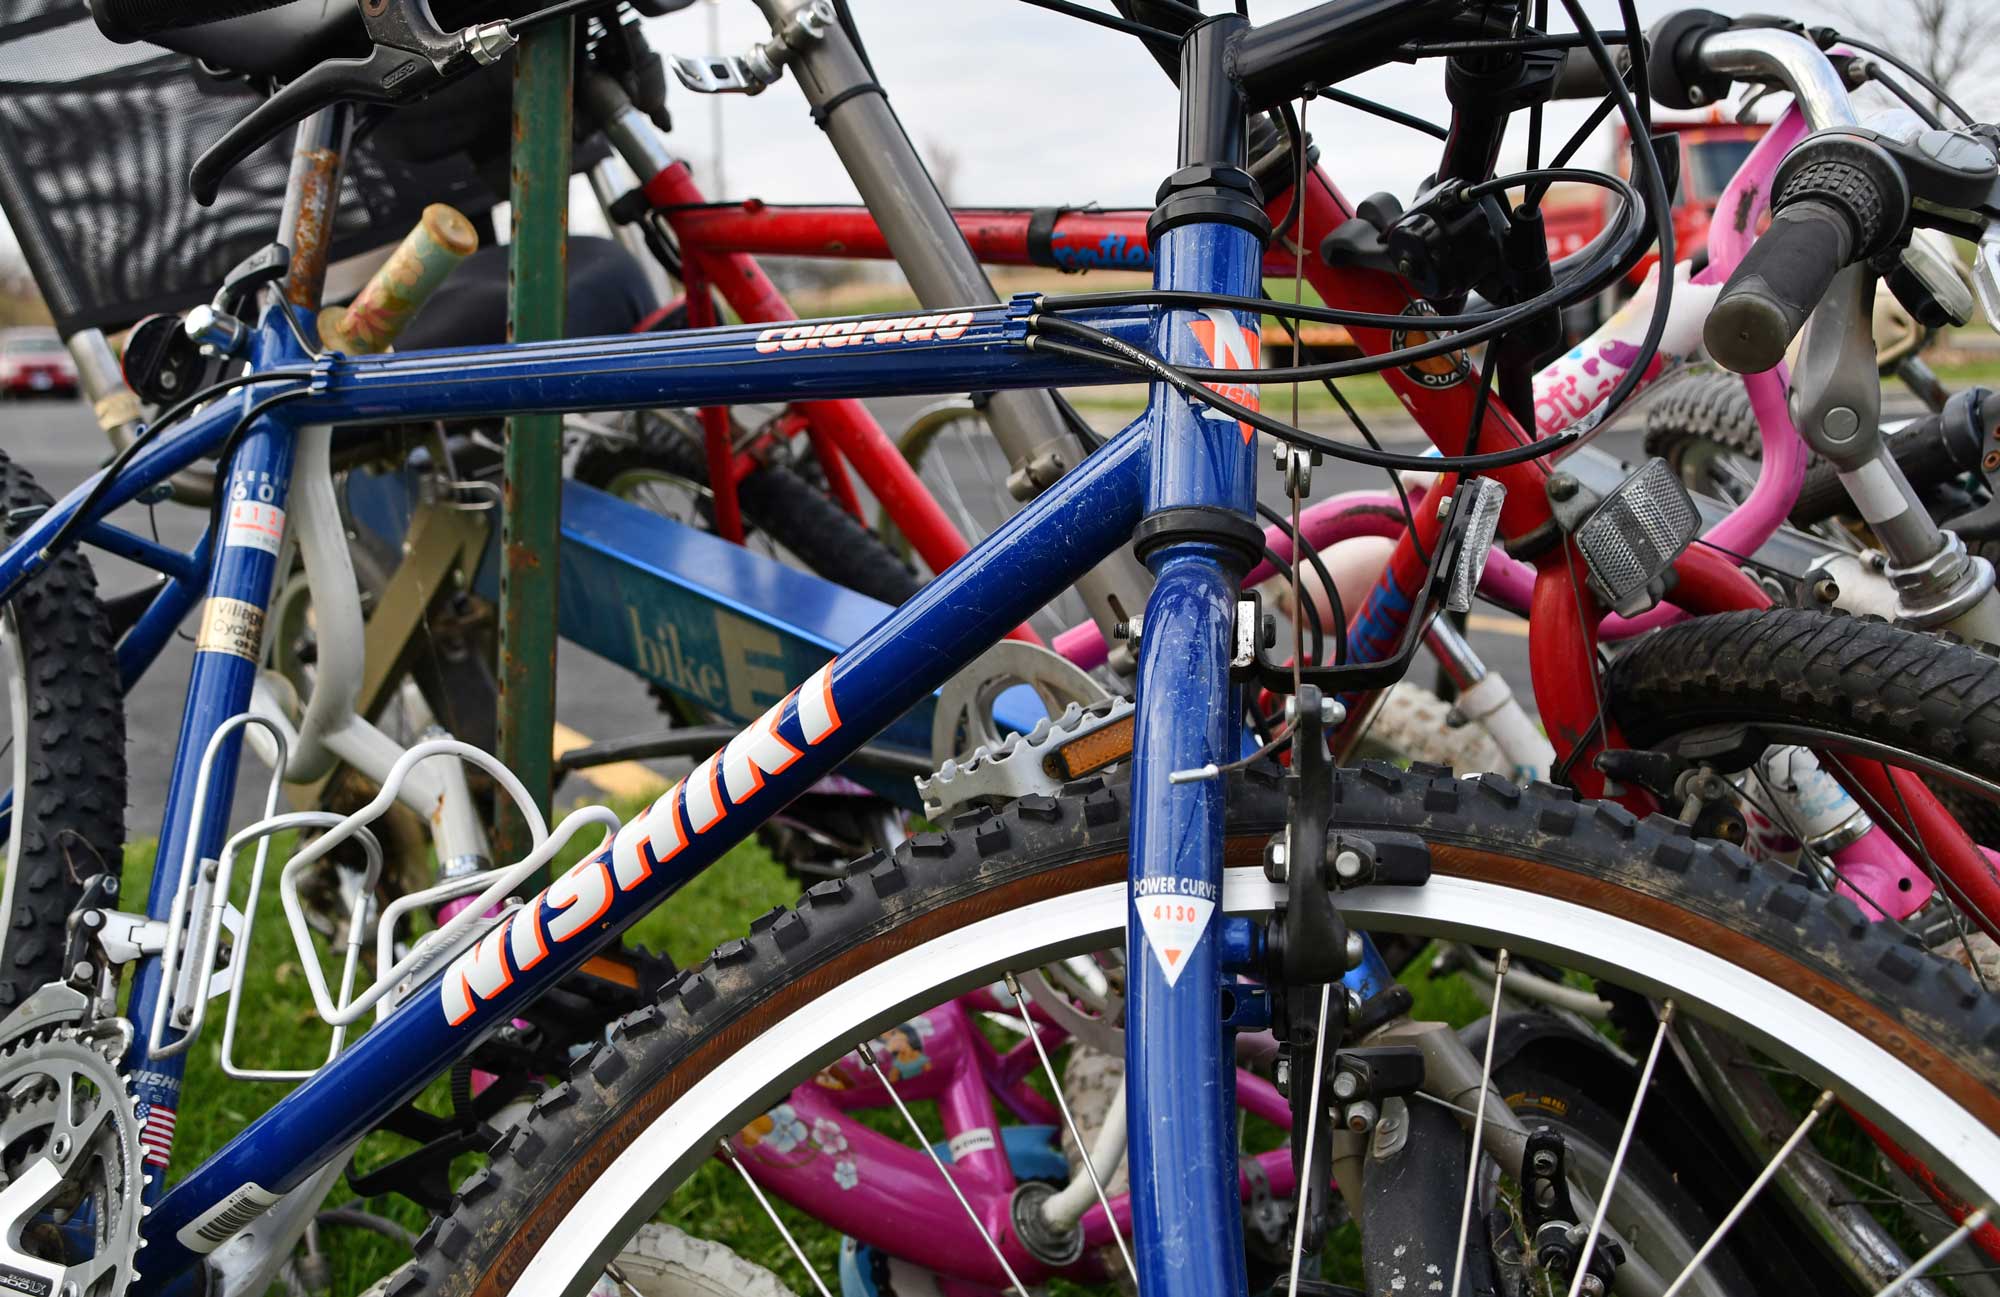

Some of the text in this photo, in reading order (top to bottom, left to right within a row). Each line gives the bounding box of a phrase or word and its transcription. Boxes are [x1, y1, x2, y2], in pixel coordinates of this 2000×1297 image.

[1137, 353, 1158, 370] SIS
[628, 607, 726, 709] bike
[440, 656, 842, 1027] NISHIKI
[1133, 876, 1217, 900] POWER CURVE
[1153, 904, 1196, 923] 4130
